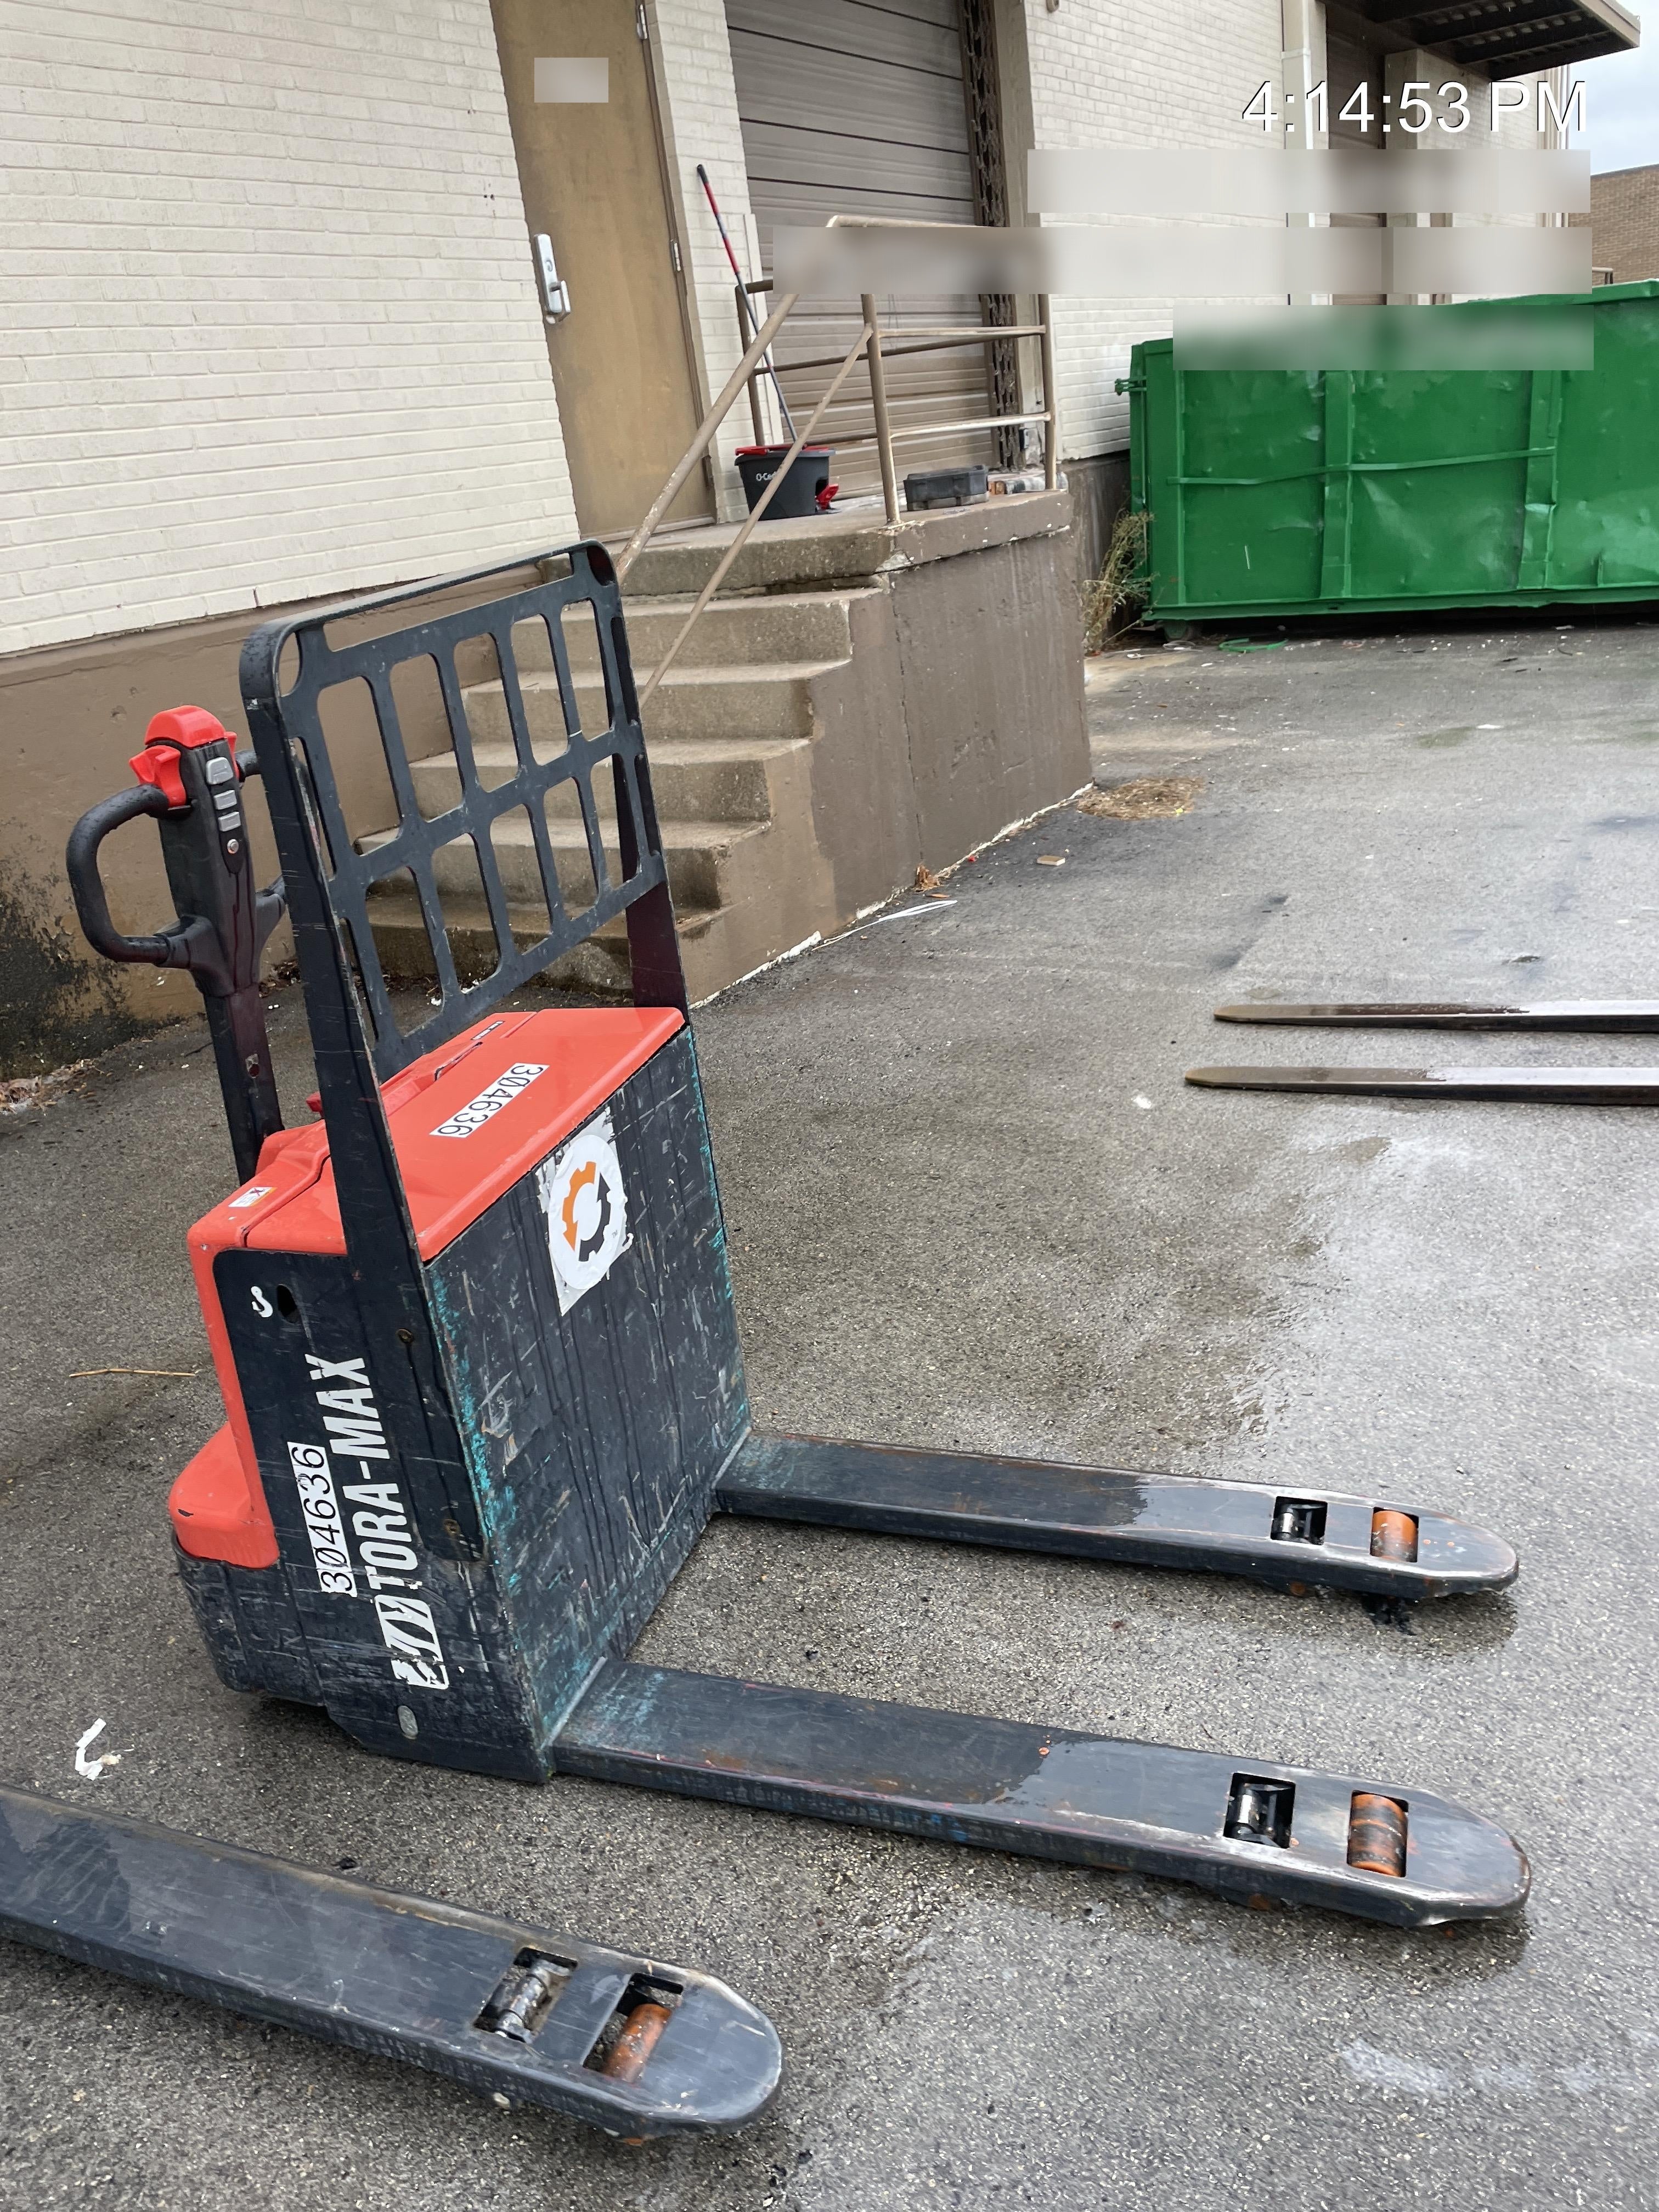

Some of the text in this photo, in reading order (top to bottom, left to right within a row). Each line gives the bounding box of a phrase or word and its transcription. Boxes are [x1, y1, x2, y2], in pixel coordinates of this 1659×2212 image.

[437, 1065, 544, 1136] 304636
[291, 1447, 353, 1592] 304636
[304, 1353, 420, 1590] TORA-MAX
